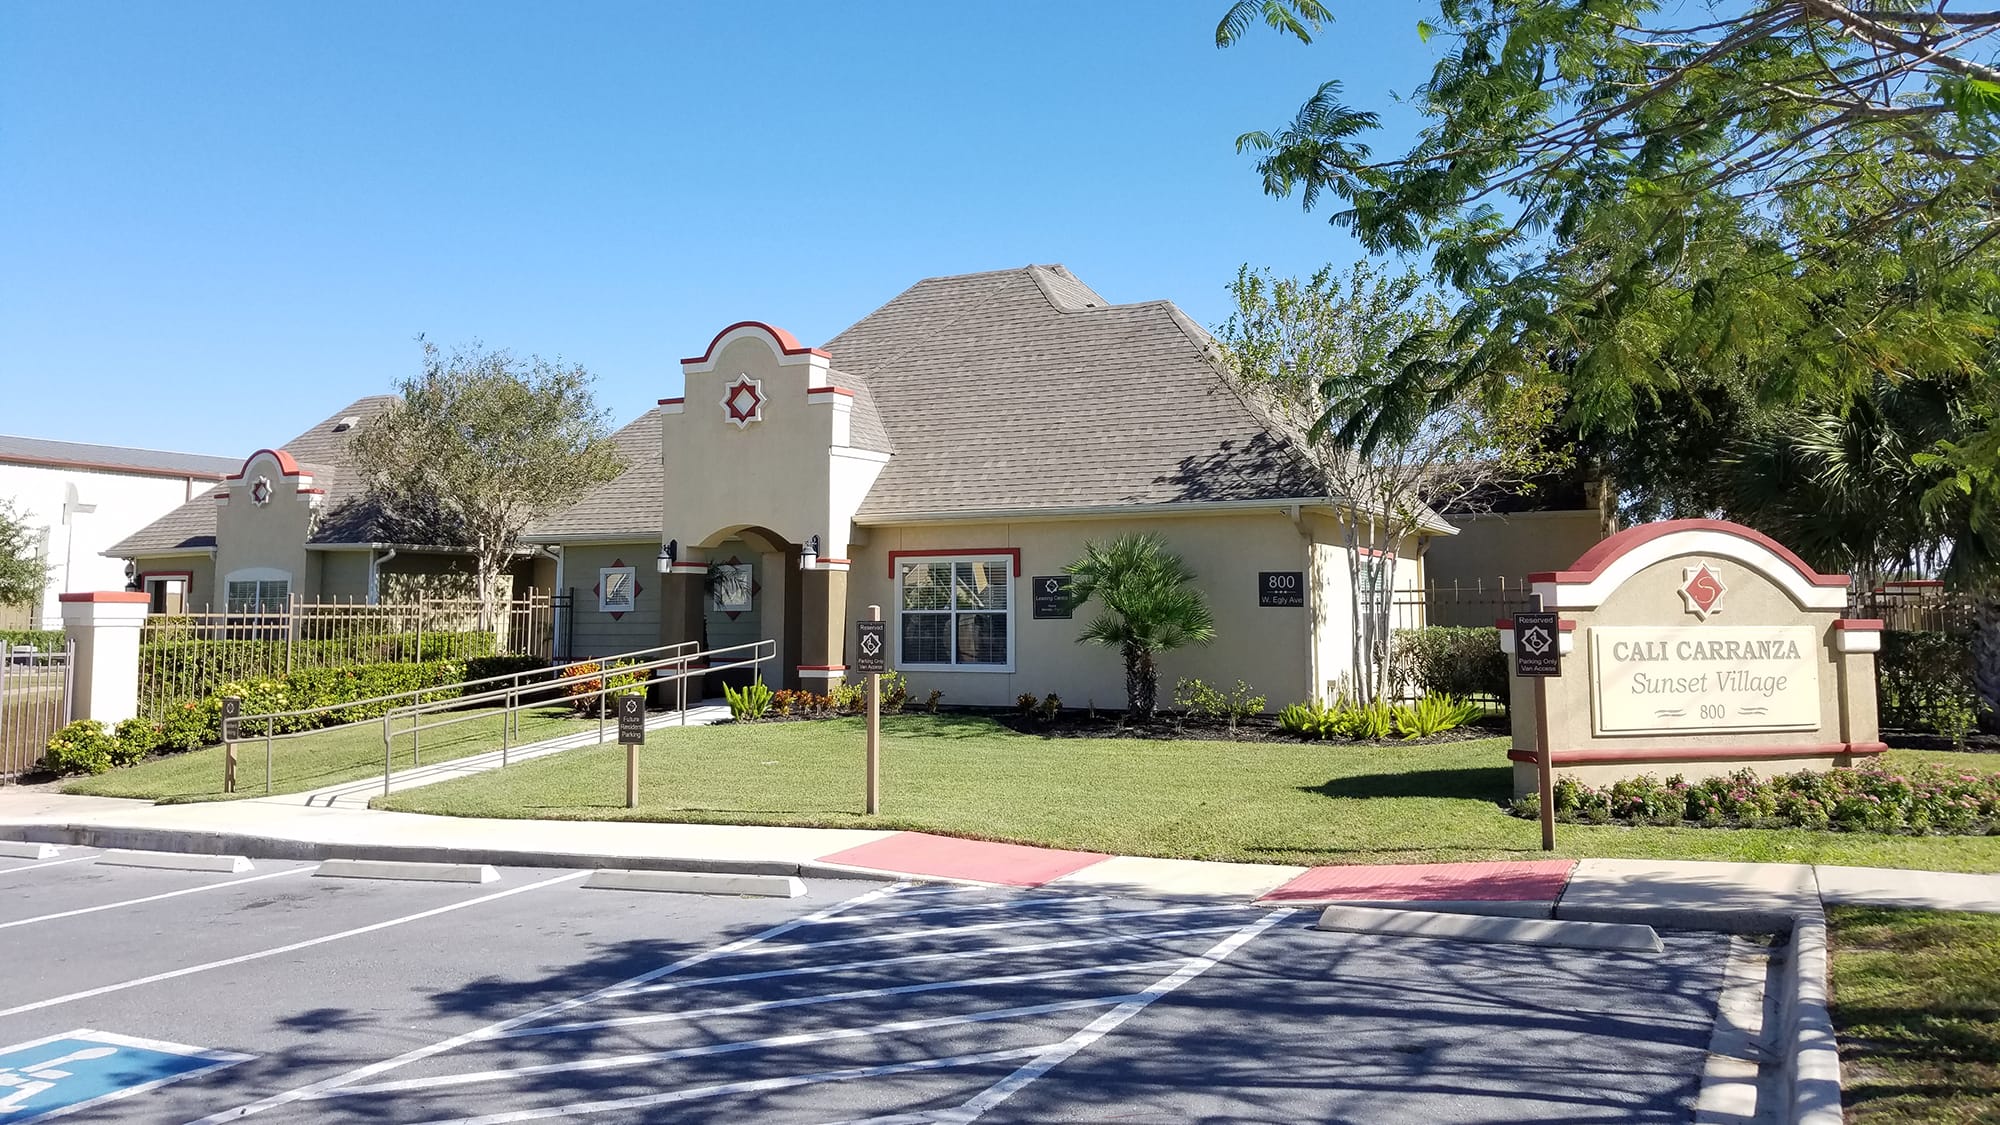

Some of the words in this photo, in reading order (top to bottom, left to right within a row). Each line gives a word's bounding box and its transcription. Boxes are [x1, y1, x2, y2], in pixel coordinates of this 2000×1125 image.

[1269, 575, 1295, 589] 800
[1694, 576, 1716, 604] S
[1261, 595, 1271, 603] W.
[1272, 595, 1287, 605] Egly
[1518, 616, 1554, 624] Reserved
[1612, 641, 1669, 662] CALI
[1675, 640, 1802, 661] CARRANZA
[1518, 658, 1543, 666] Parking
[1543, 658, 1558, 666] Only
[1631, 672, 1708, 695] Sunset
[1716, 670, 1788, 698] Village
[1700, 703, 1726, 720] 800
